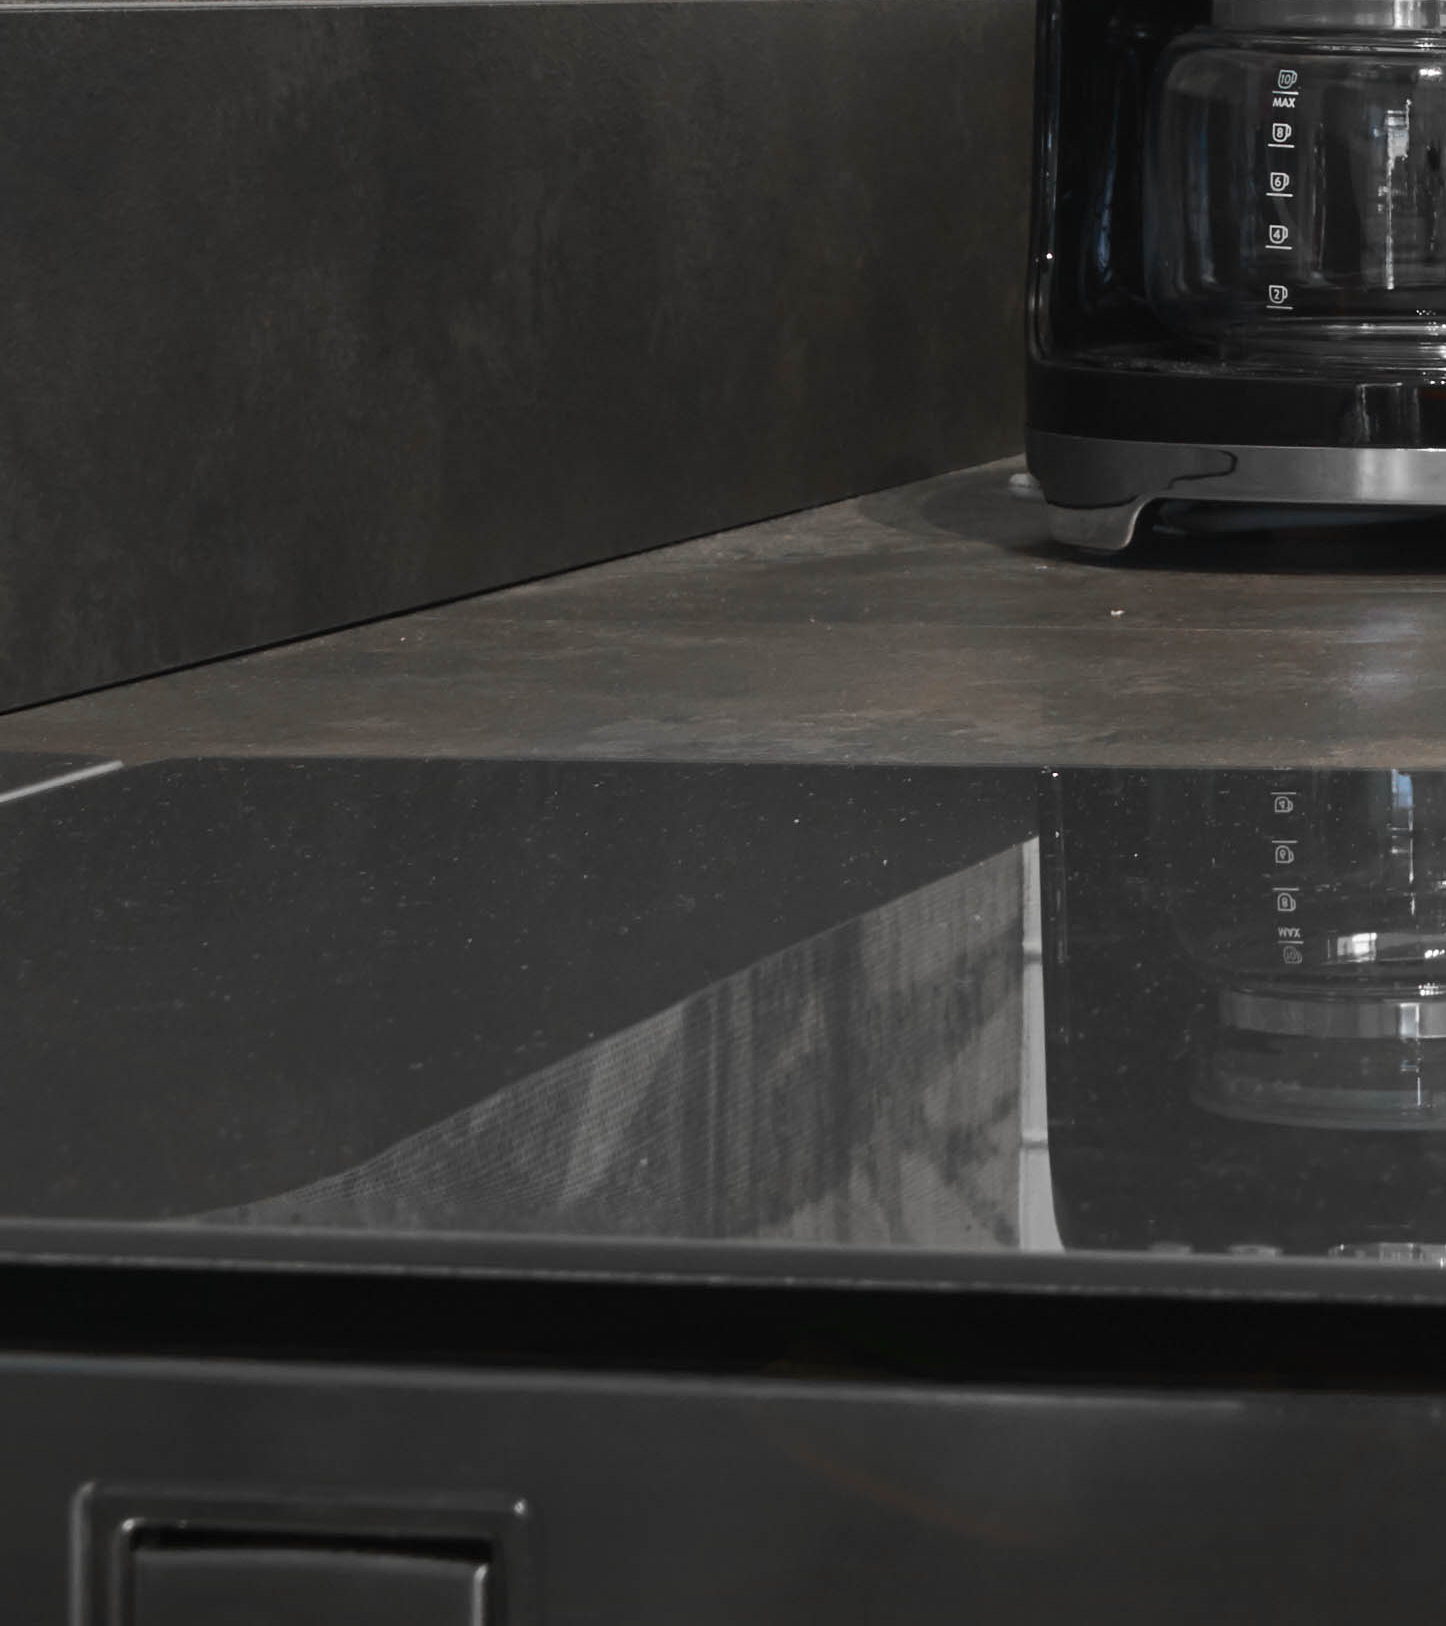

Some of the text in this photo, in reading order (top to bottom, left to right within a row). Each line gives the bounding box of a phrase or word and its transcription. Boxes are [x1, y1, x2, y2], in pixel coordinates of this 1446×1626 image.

[1280, 73, 1292, 85] 10
[1272, 97, 1296, 108] MAX
[1276, 127, 1284, 139] 8
[1274, 176, 1282, 188] 6
[1273, 228, 1281, 241] 4
[1273, 288, 1280, 301] 2
